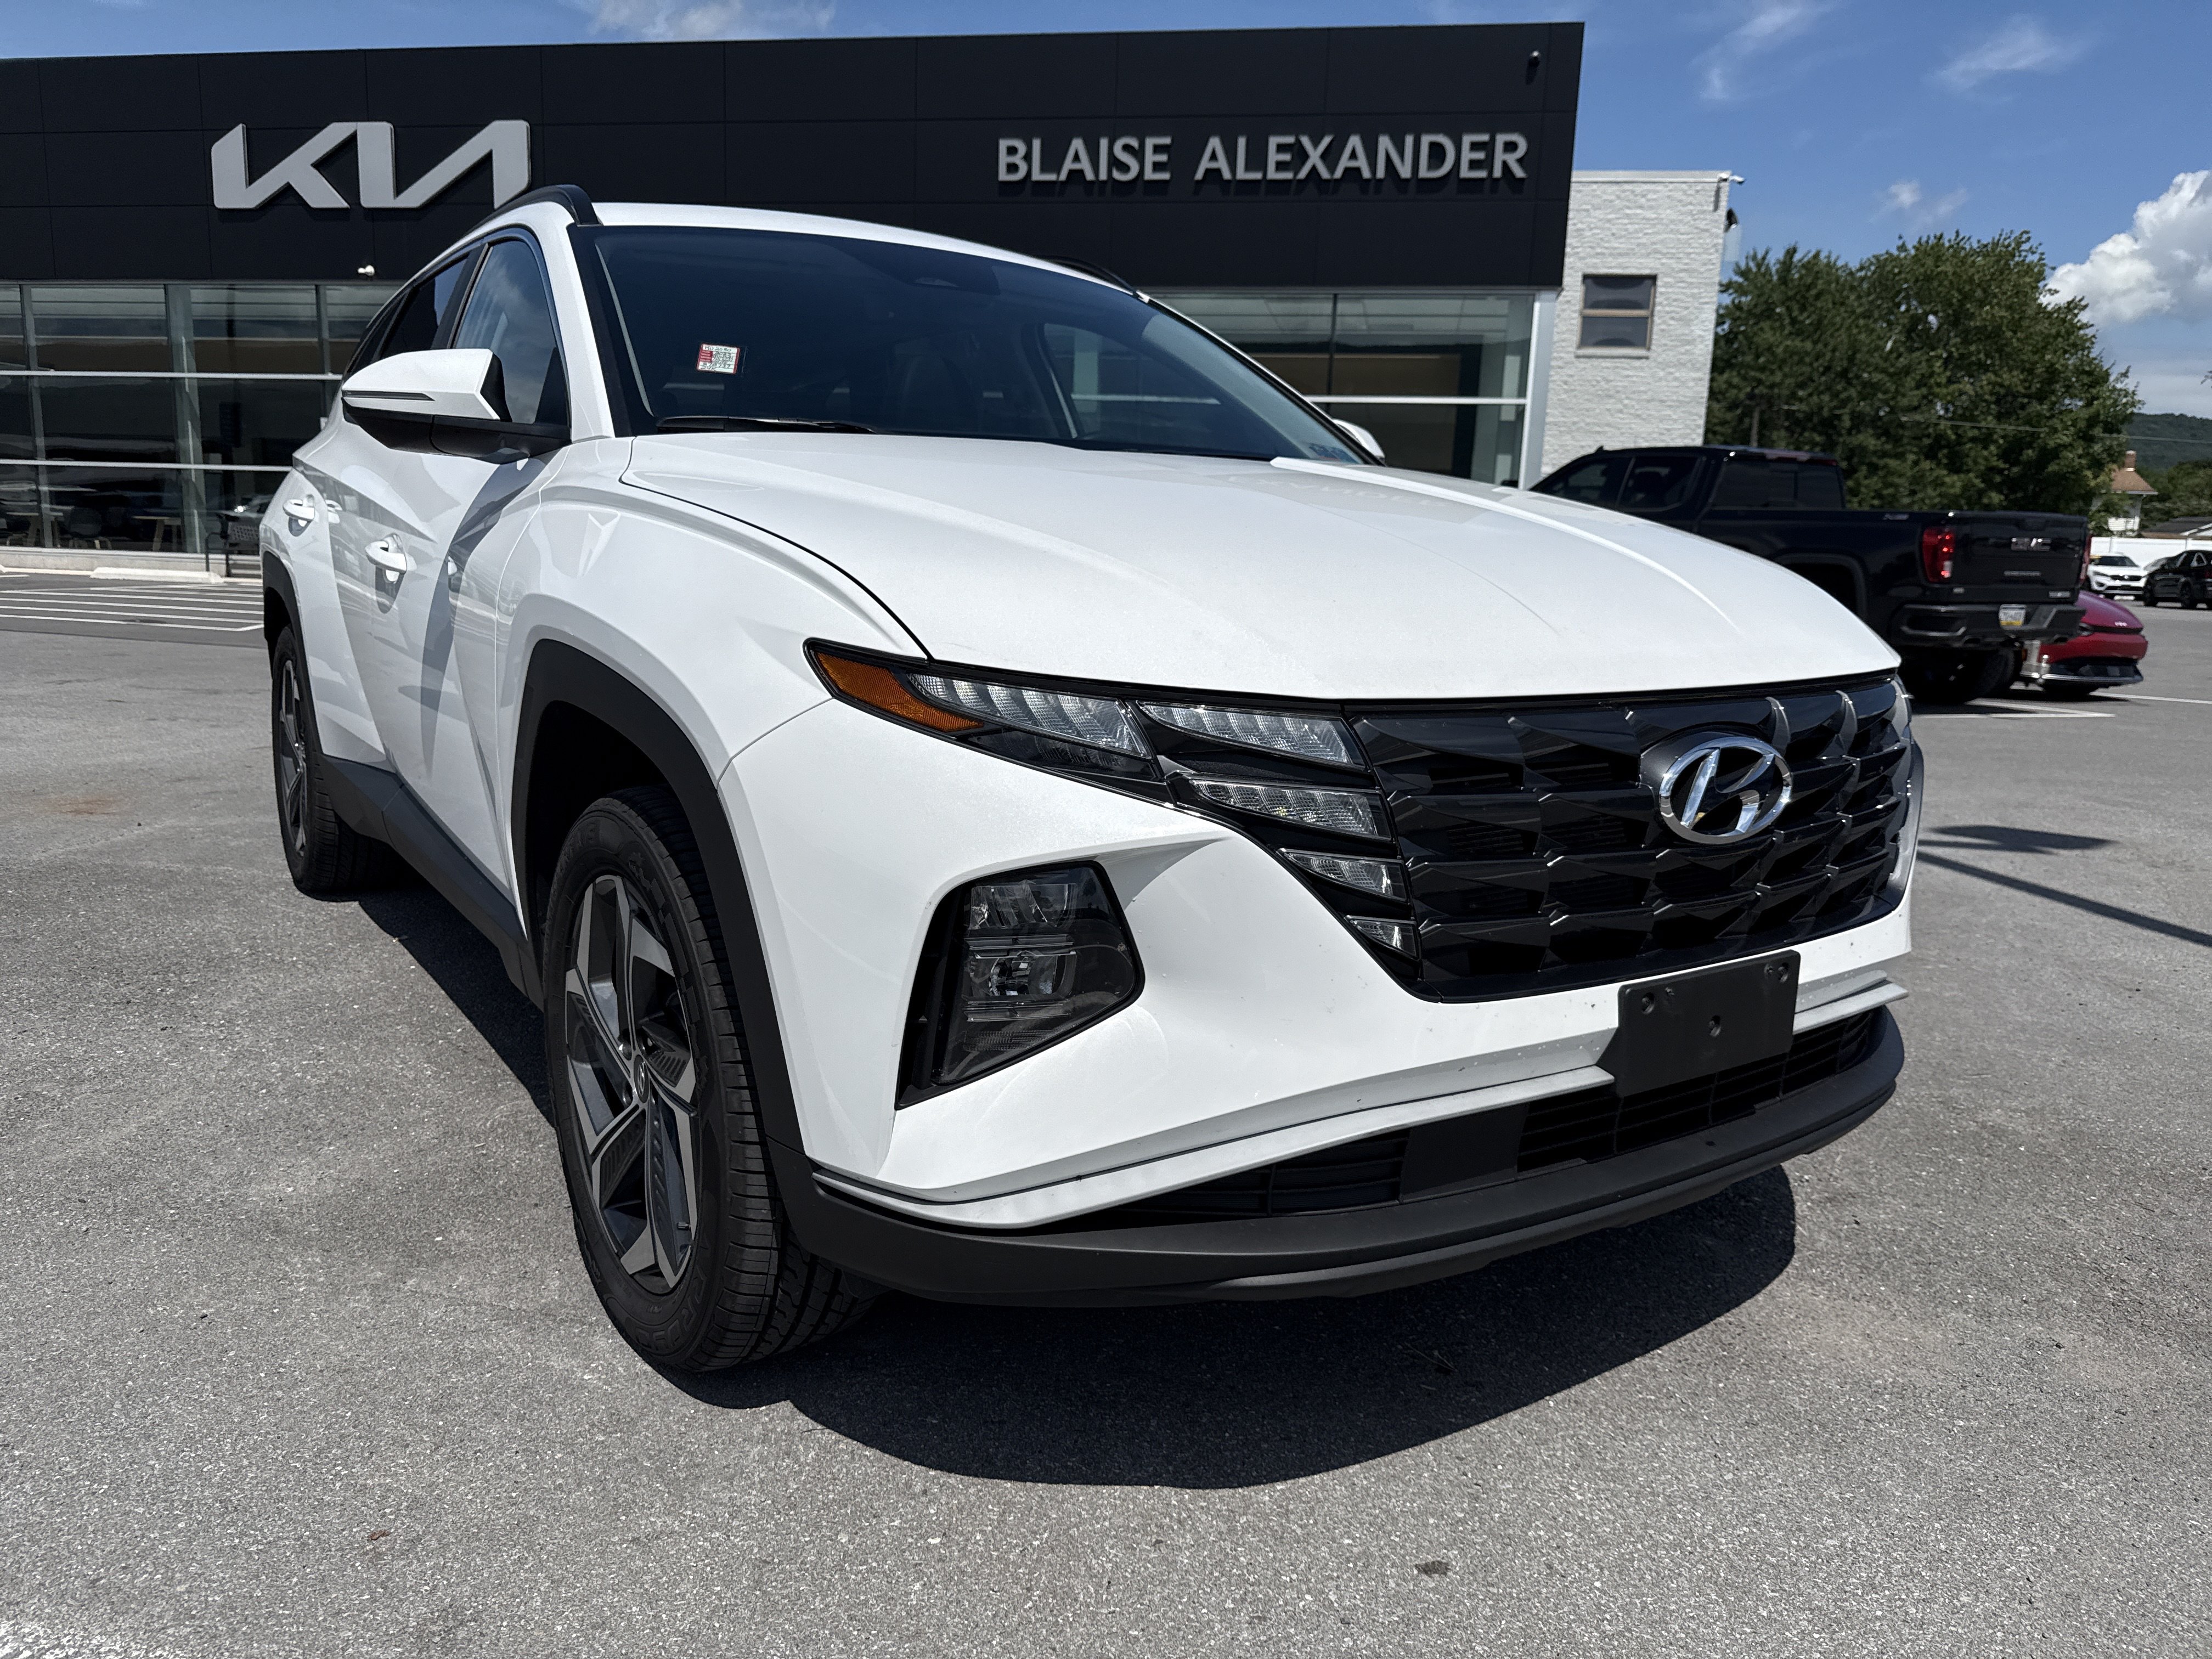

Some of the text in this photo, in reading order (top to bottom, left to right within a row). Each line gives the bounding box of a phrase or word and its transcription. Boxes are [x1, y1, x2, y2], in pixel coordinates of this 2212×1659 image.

[211, 119, 531, 210] KIA
[997, 132, 1528, 182] BLAISE ALEXANDER
